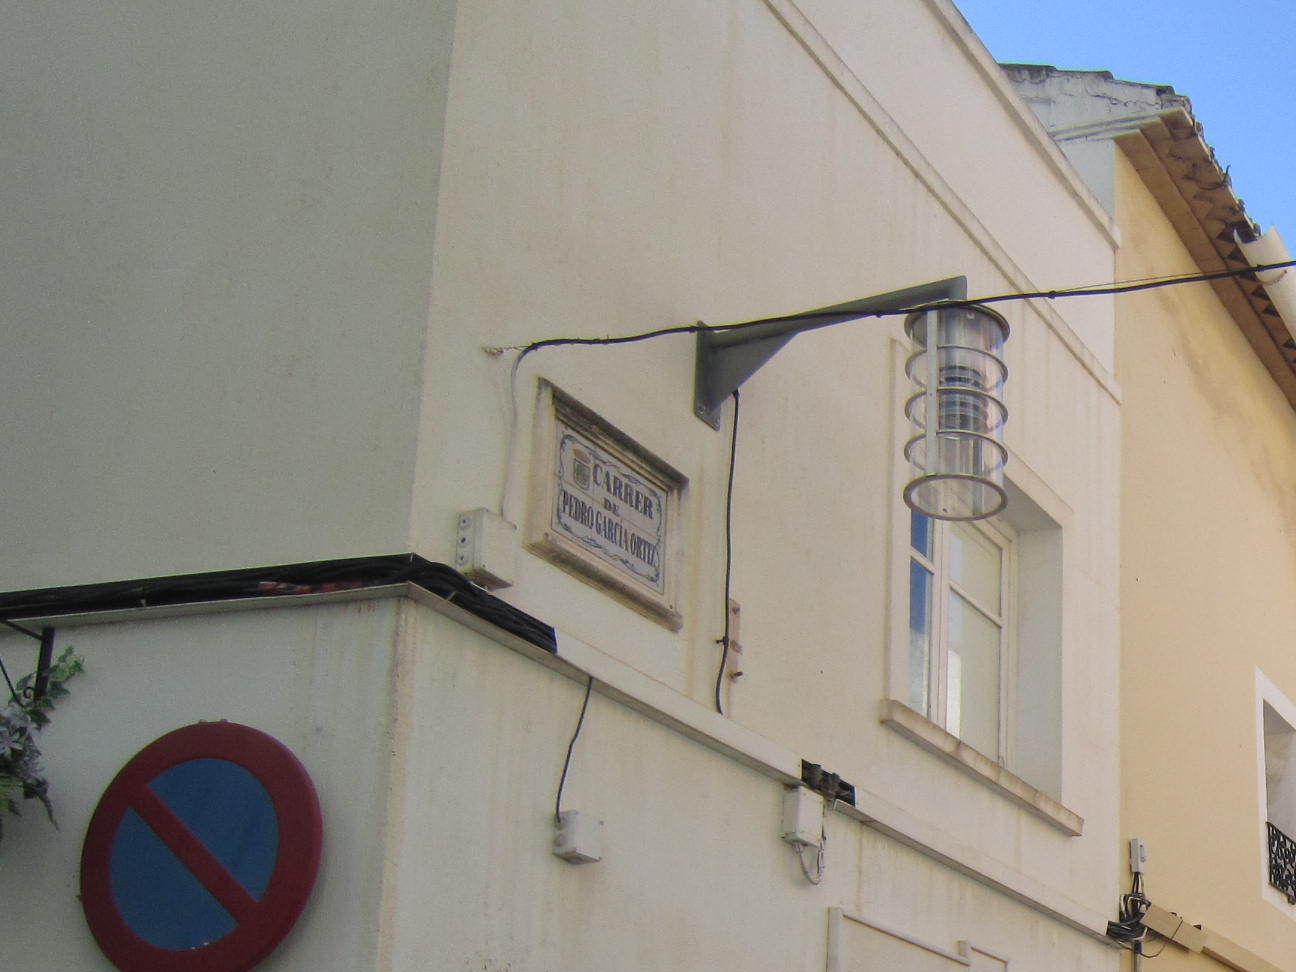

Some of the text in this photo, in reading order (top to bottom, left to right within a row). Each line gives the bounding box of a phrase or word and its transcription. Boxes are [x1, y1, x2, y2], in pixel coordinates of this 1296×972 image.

[593, 464, 653, 520] CARRER
[603, 498, 620, 517] DE
[562, 490, 658, 567] PEDRO GARCÍA ORTIZ
